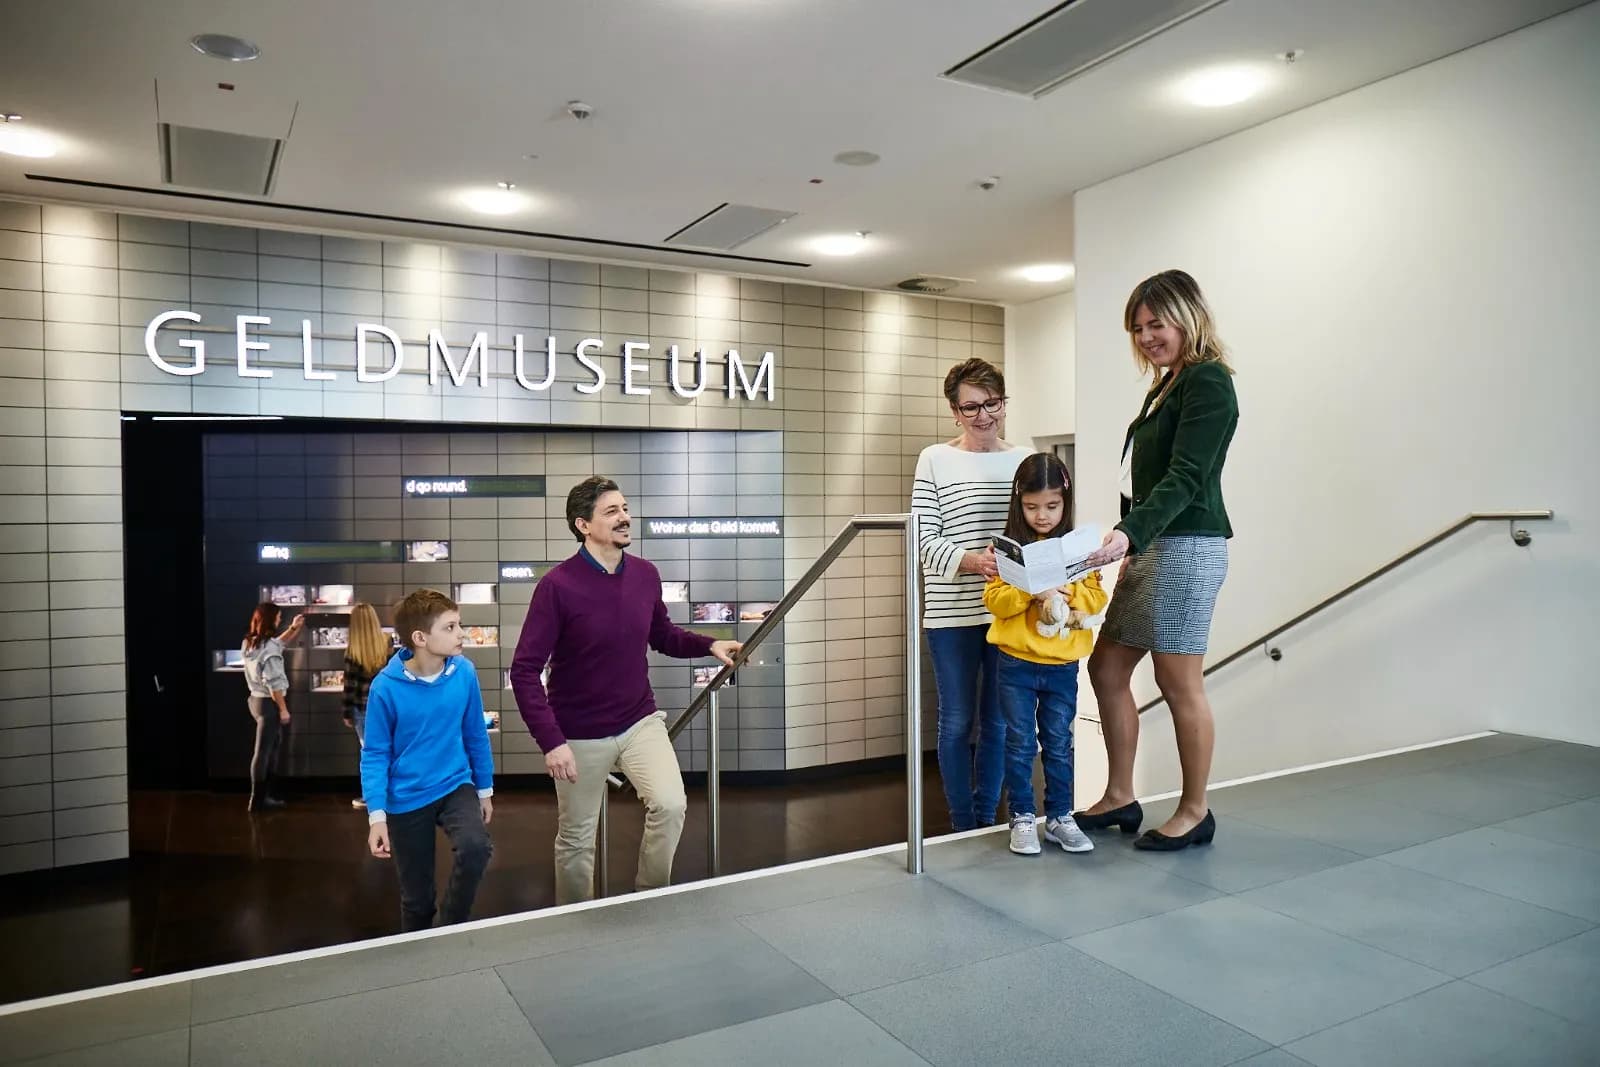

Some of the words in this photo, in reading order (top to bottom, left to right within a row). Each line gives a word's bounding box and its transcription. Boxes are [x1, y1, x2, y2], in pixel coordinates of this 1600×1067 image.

[144, 310, 776, 403] GELDMUSEUM
[416, 481, 432, 495] go
[432, 480, 468, 493] round.
[649, 521, 687, 534] Woher
[688, 521, 710, 534] das
[710, 521, 738, 534] Geld
[739, 521, 780, 535] kommt,
